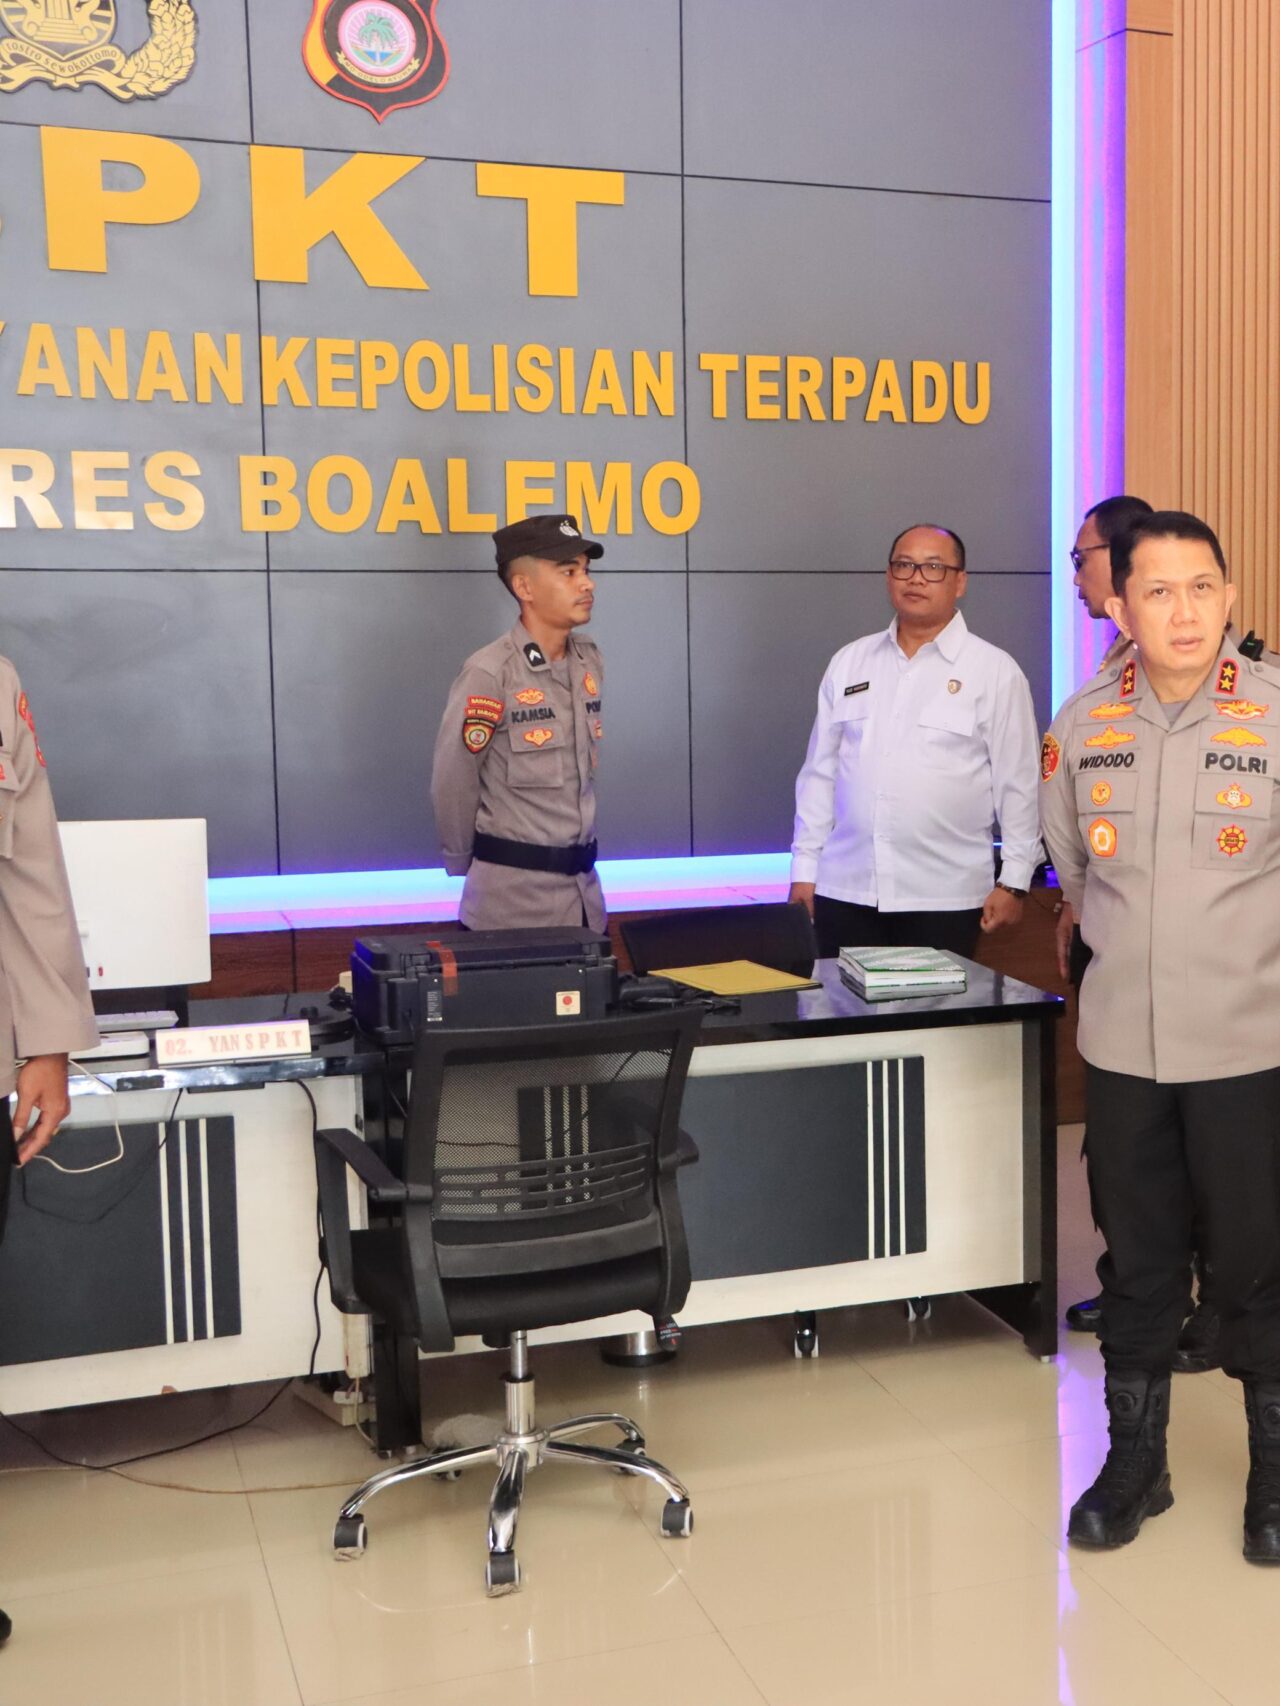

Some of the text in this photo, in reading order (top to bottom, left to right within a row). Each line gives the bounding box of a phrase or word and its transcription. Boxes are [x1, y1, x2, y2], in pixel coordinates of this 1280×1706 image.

[0, 125, 625, 297] PKT
[0, 320, 990, 425] ANAN KEPOLISIAN TERPADU
[0, 449, 701, 535] RES BOALEMO
[1078, 752, 1135, 770] WIDODO
[1205, 752, 1267, 774] POLRI
